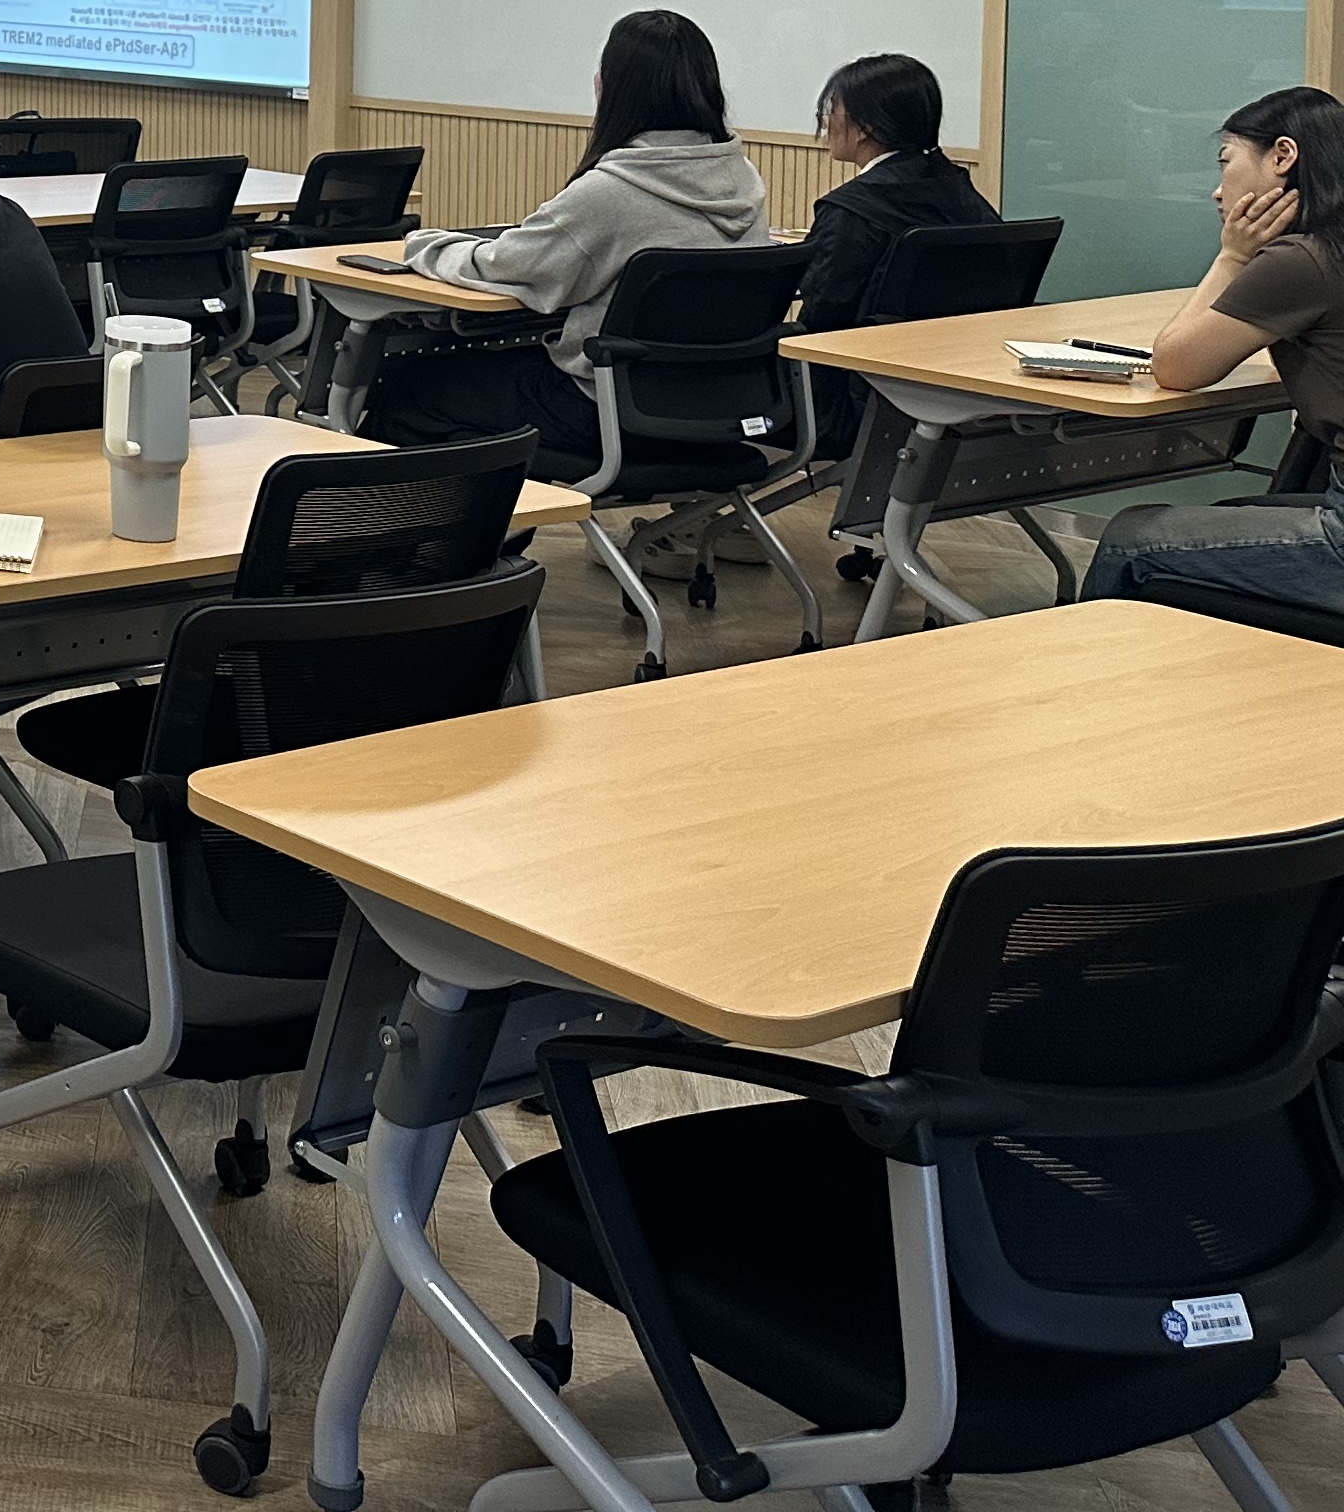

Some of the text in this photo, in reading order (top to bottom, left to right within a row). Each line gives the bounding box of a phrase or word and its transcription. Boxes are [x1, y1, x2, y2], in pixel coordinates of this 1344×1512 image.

[1, 29, 43, 46] TREM2
[45, 32, 102, 51] mediated
[105, 37, 189, 60] ePtdSer-Aβ?
